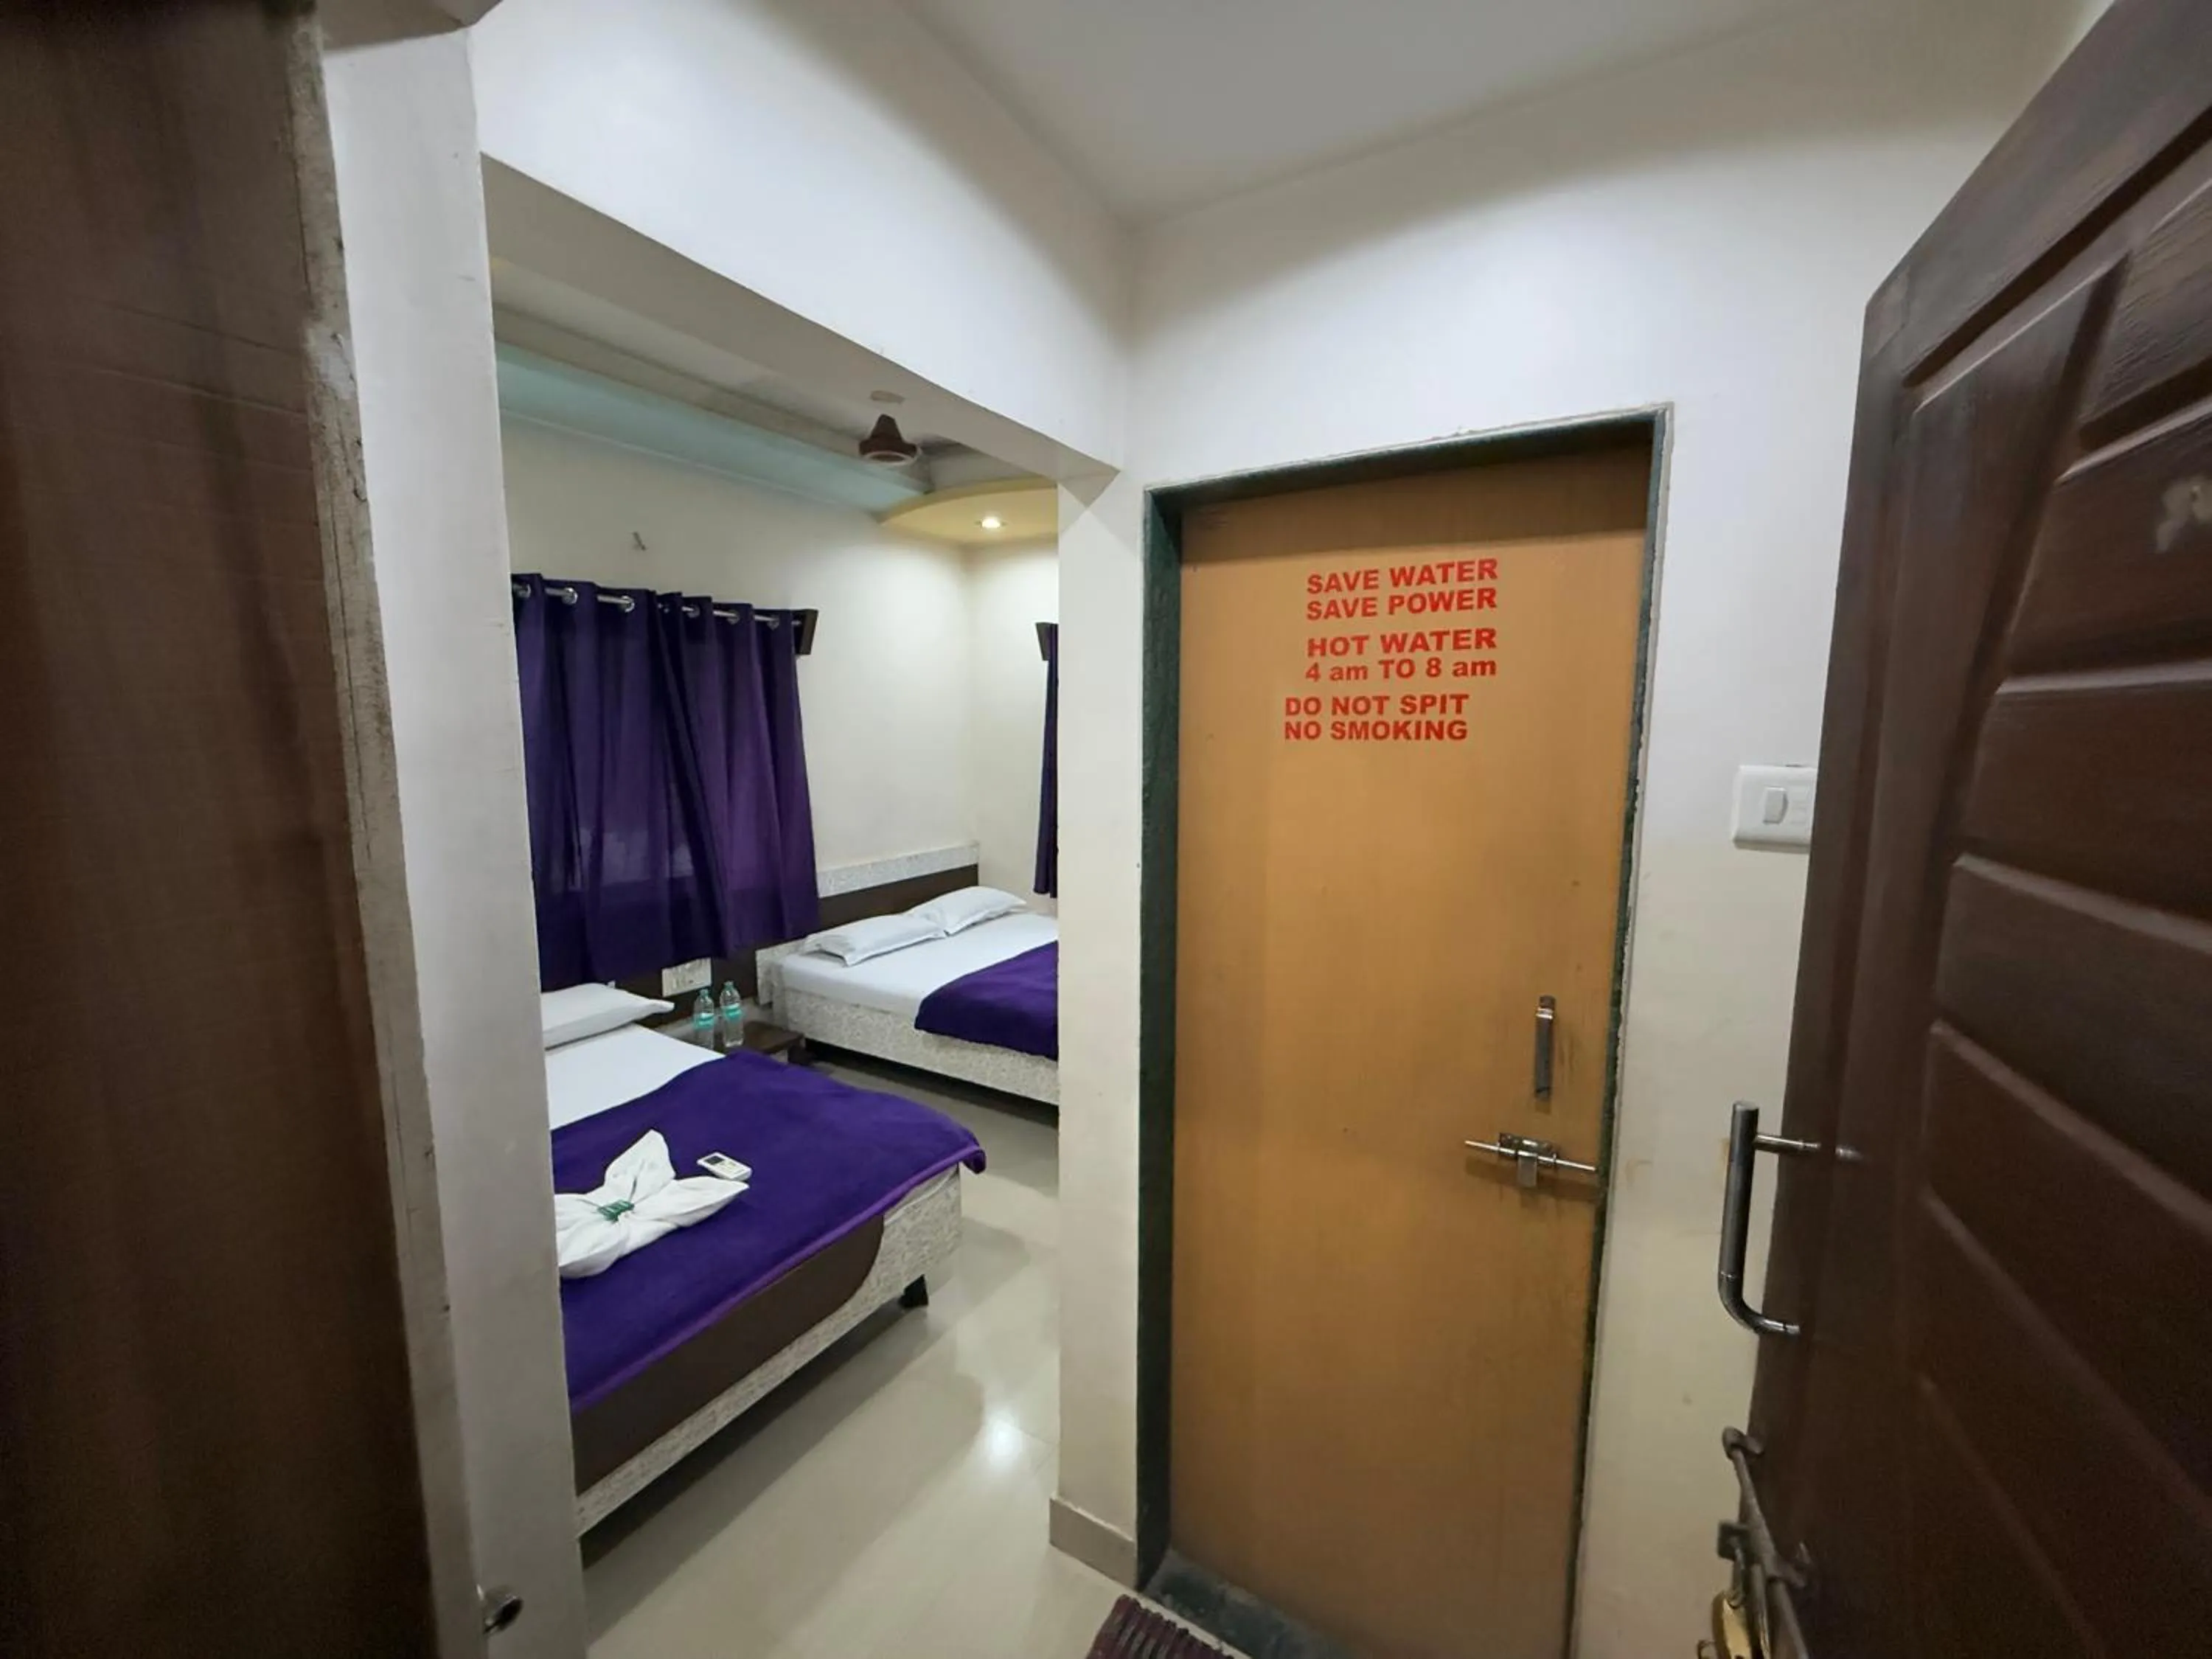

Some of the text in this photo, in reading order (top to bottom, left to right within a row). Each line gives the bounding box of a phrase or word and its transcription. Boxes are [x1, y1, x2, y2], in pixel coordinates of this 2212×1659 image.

[1307, 558, 1498, 594] SAVE WATER
[1307, 588, 1498, 620] SAVE POWER
[1307, 628, 1498, 658] HOT WATER
[1305, 657, 1497, 682] 4 am TO 8 am
[1284, 694, 1470, 716] DO NOT SPIT
[1284, 720, 1467, 741] NO SMOKING
